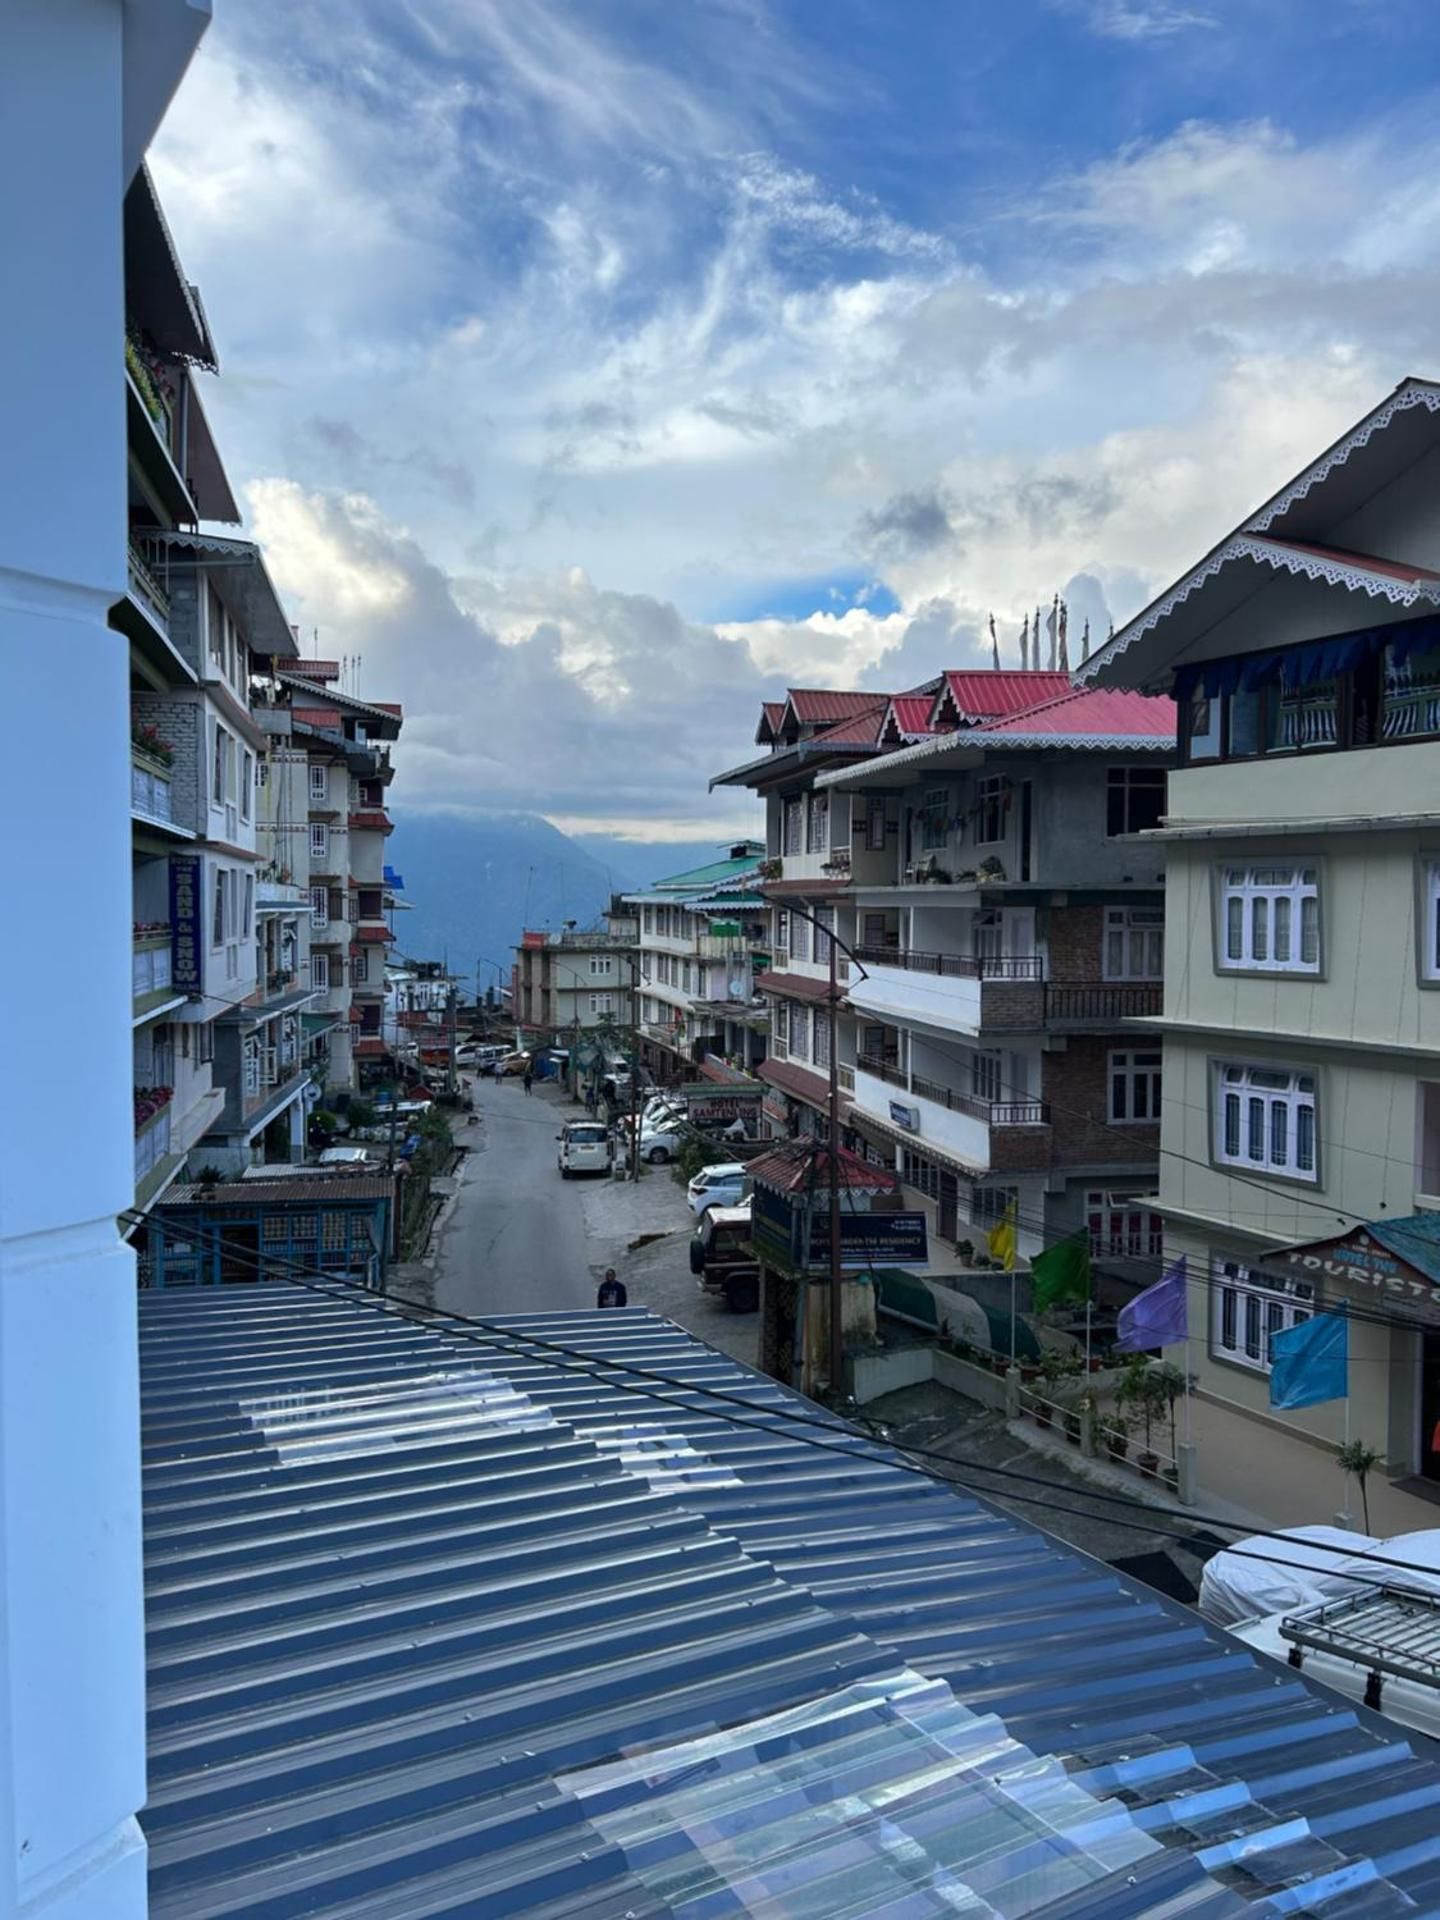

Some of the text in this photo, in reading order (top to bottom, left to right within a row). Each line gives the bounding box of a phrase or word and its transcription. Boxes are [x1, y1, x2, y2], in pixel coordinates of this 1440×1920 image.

[174, 873, 198, 982] SAND & SNOW
[710, 1098, 740, 1108] HOTEL
[1333, 1248, 1370, 1267] HOTEL
